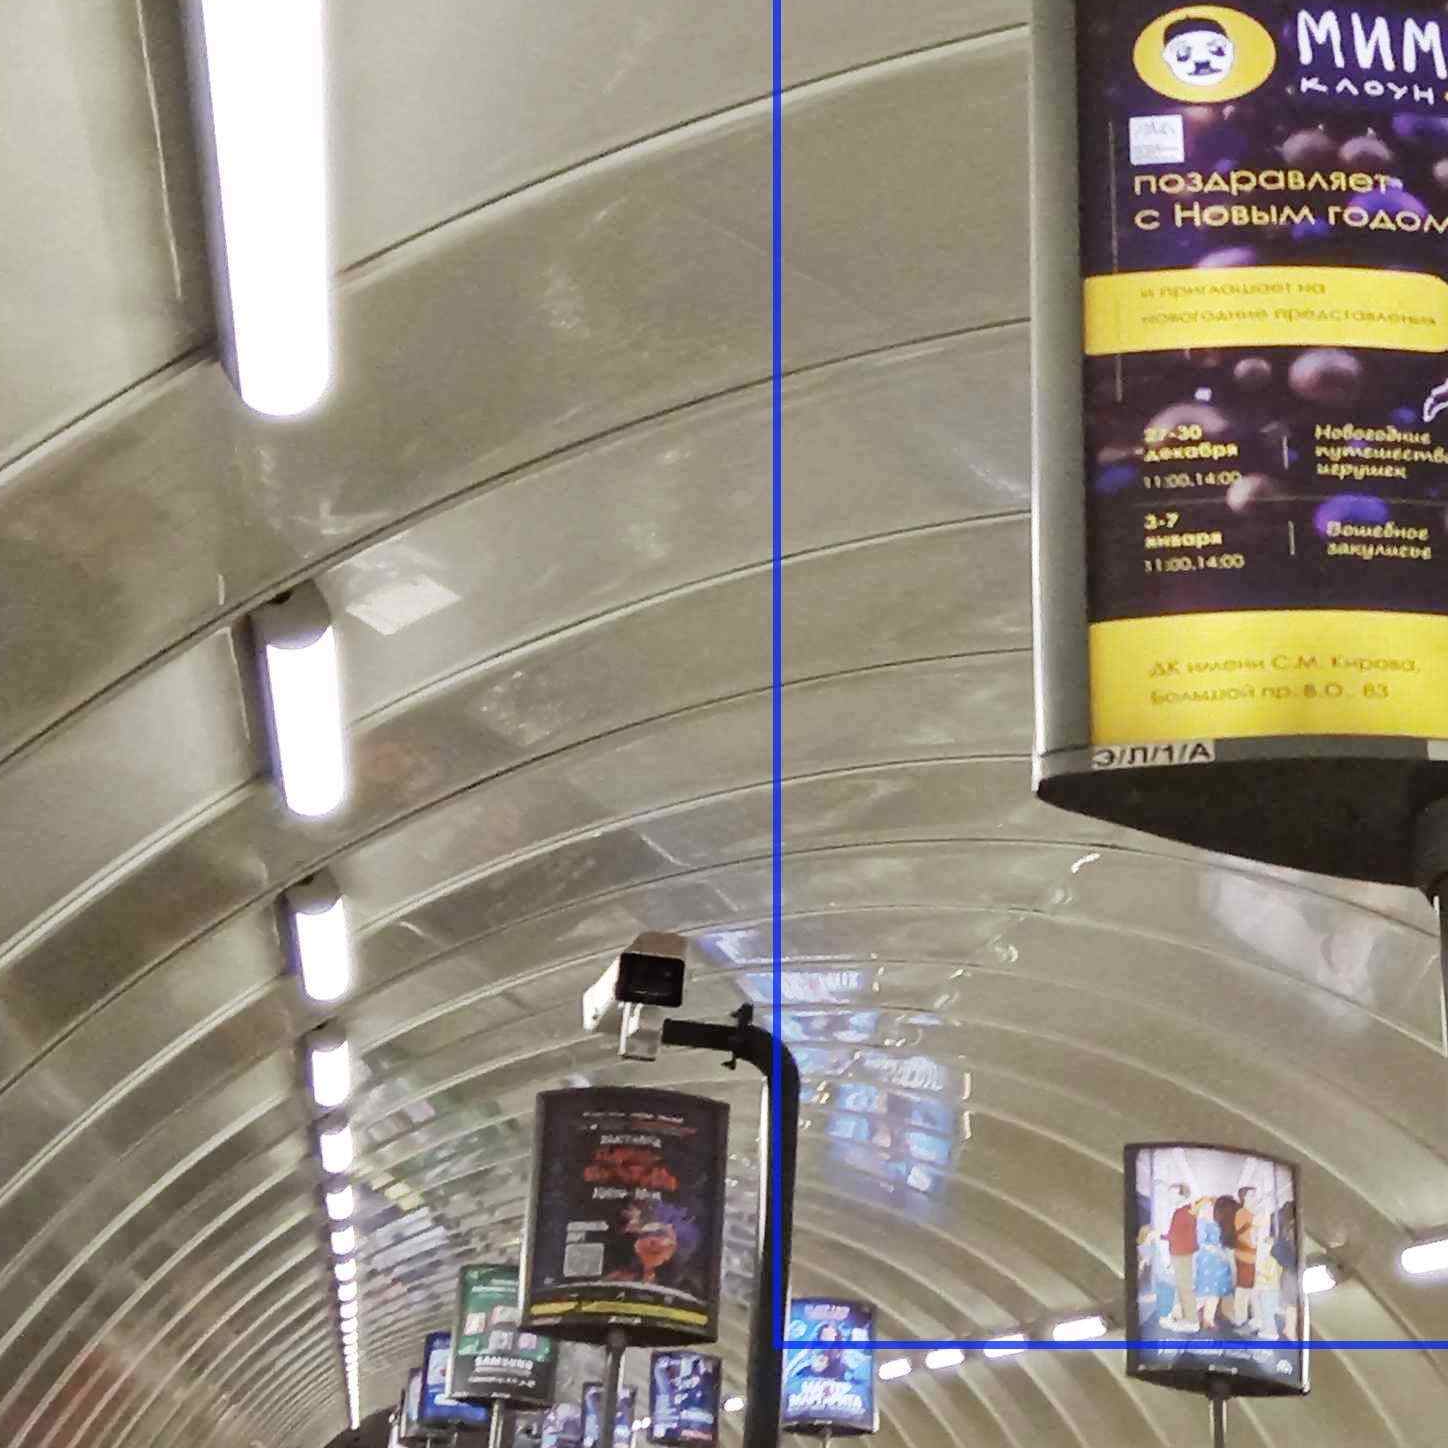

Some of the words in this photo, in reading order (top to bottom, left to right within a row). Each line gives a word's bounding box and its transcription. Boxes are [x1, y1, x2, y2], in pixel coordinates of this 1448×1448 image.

[1134, 169, 1389, 196] поздравляет
[1174, 201, 1315, 228] Новым
[1143, 442, 1239, 463] декабря
